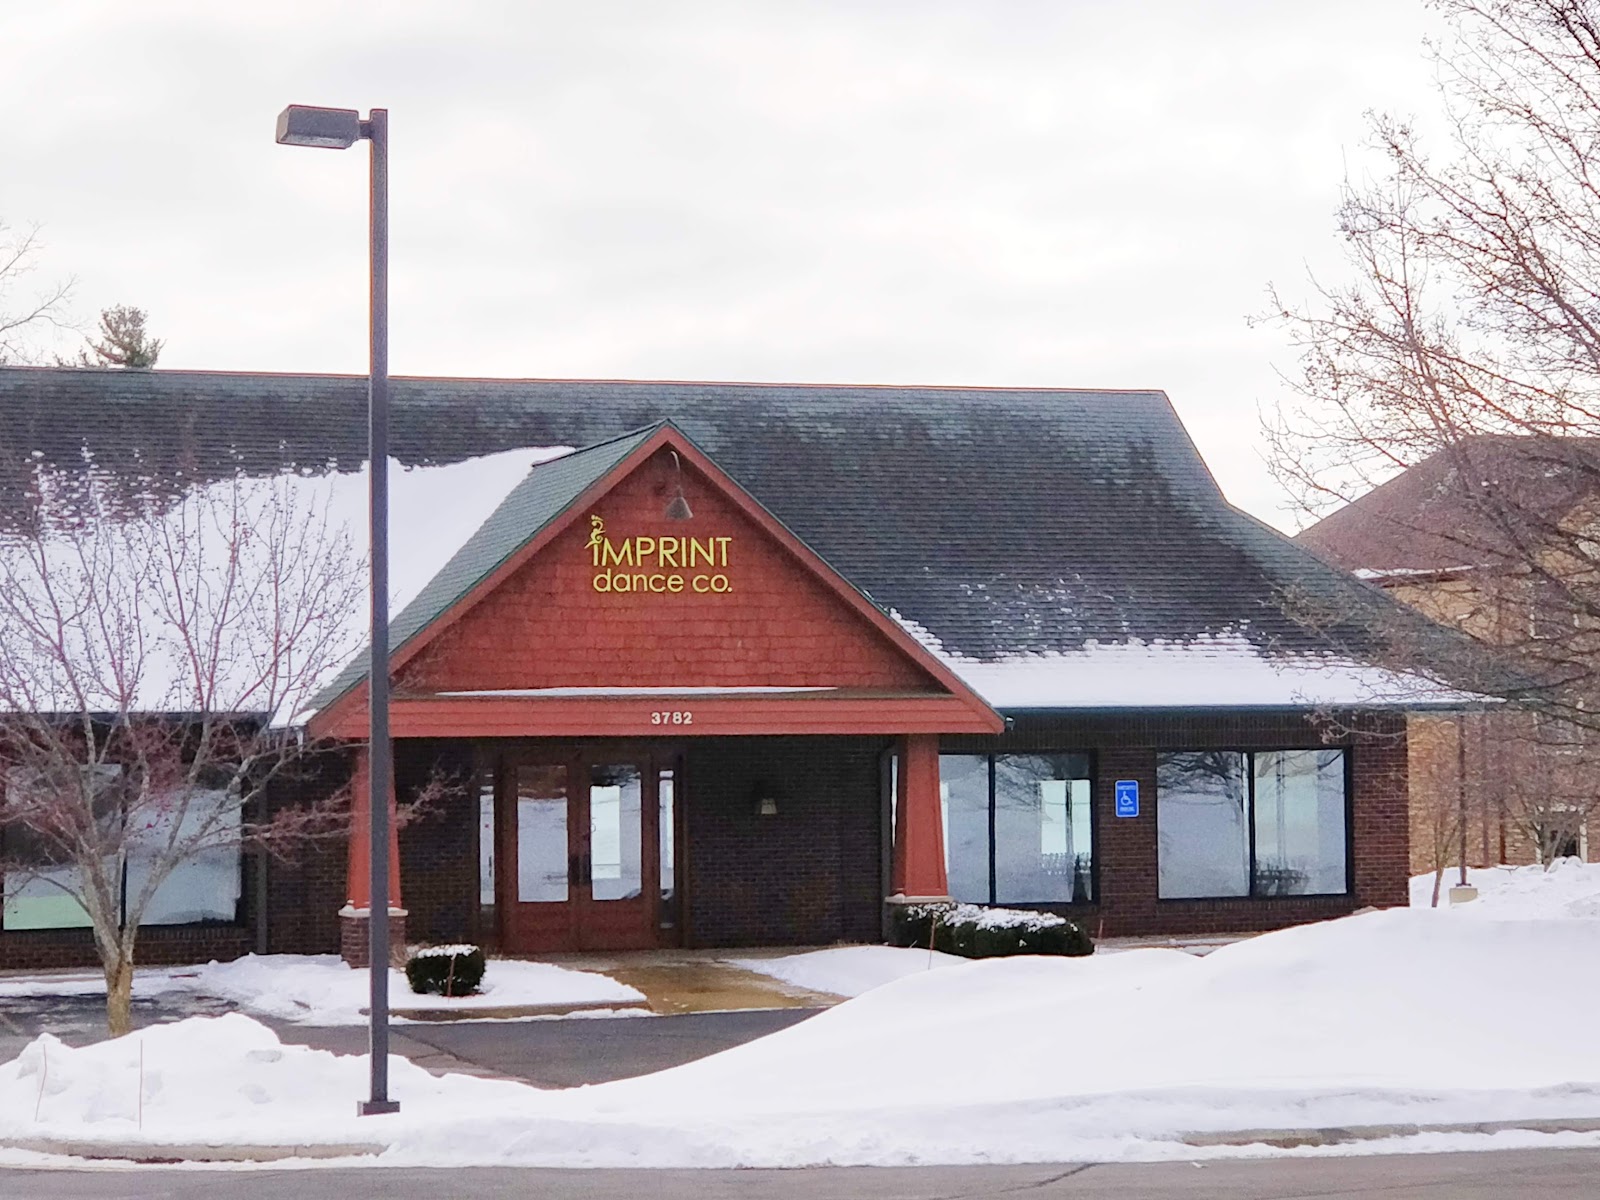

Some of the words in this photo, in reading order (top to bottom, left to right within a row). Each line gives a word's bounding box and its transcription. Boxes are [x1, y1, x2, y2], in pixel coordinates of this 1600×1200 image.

[592, 535, 733, 568] IMPRINT
[592, 568, 684, 593] dance
[692, 573, 733, 593] co.
[651, 711, 693, 725] 3782
